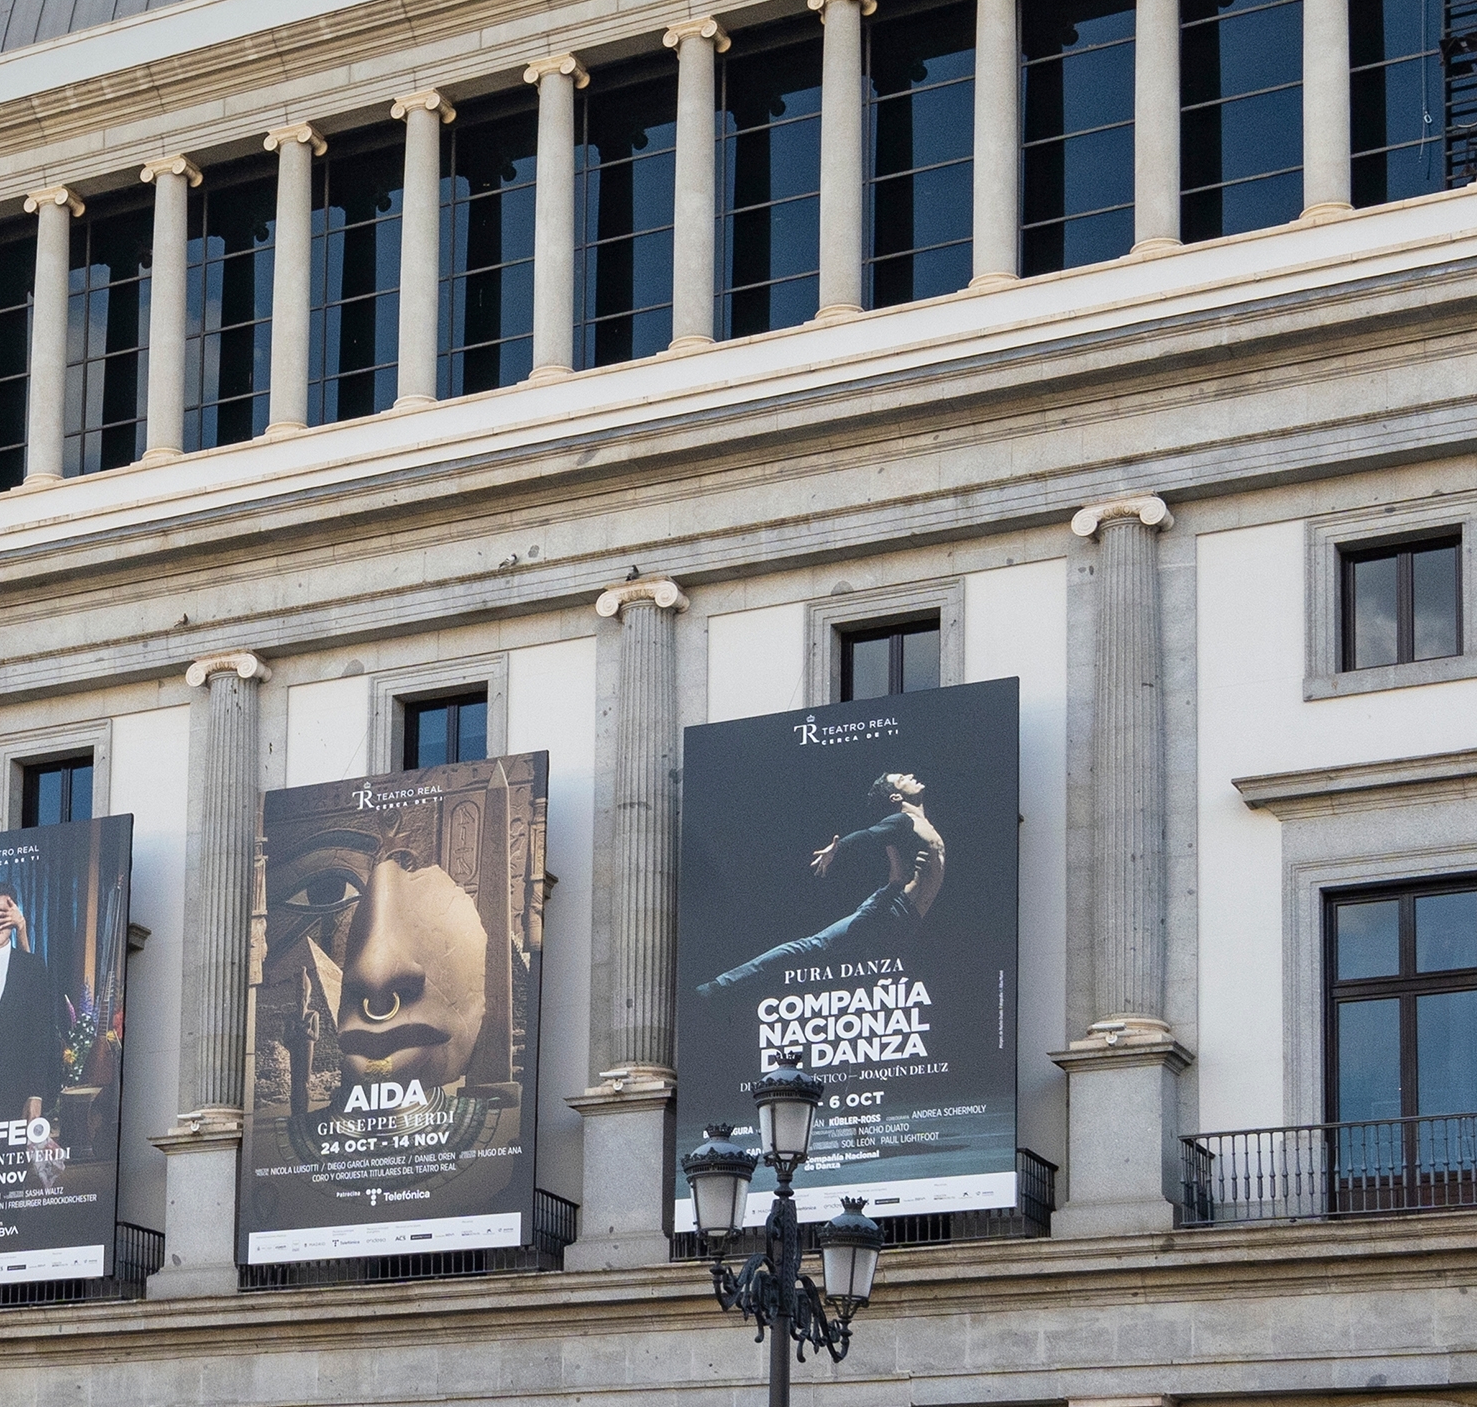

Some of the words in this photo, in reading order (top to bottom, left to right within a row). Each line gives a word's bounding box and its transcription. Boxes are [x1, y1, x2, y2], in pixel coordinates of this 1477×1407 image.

[822, 722, 865, 735] TEATRO
[869, 717, 898, 728] REAL
[377, 788, 414, 801] TEATRO
[417, 785, 442, 795] REAL
[17, 845, 40, 854] REAL
[784, 966, 833, 984] PURA
[840, 958, 904, 978] DANZA
[757, 977, 931, 1023] COMPAÑÍA
[759, 1007, 930, 1048] NACIONAL
[810, 1033, 928, 1067] DANZA
[859, 1066, 907, 1082] JOAQUÍN
[909, 1065, 925, 1075] DE
[927, 1063, 949, 1073] LUZ
[344, 1079, 428, 1113] AIDA
[829, 1096, 840, 1108] 6
[846, 1092, 884, 1107] OCT
[317, 1115, 397, 1136] GIUSEPPE
[403, 1111, 454, 1127] VERDI
[828, 1114, 881, 1126] KÜBLER-ROSS
[912, 1108, 942, 1119] ANDREA
[944, 1105, 986, 1117] SCHERMOLY
[858, 1125, 884, 1135] NACHO
[885, 1123, 909, 1133] DUATO
[320, 1141, 340, 1155] 24
[344, 1138, 377, 1152] OCT
[392, 1135, 409, 1148] 14
[414, 1132, 450, 1146] NOV
[25, 1189, 44, 1197] SASHA
[44, 1187, 63, 1195] WALTZ
[383, 1190, 430, 1201] Telefónica
